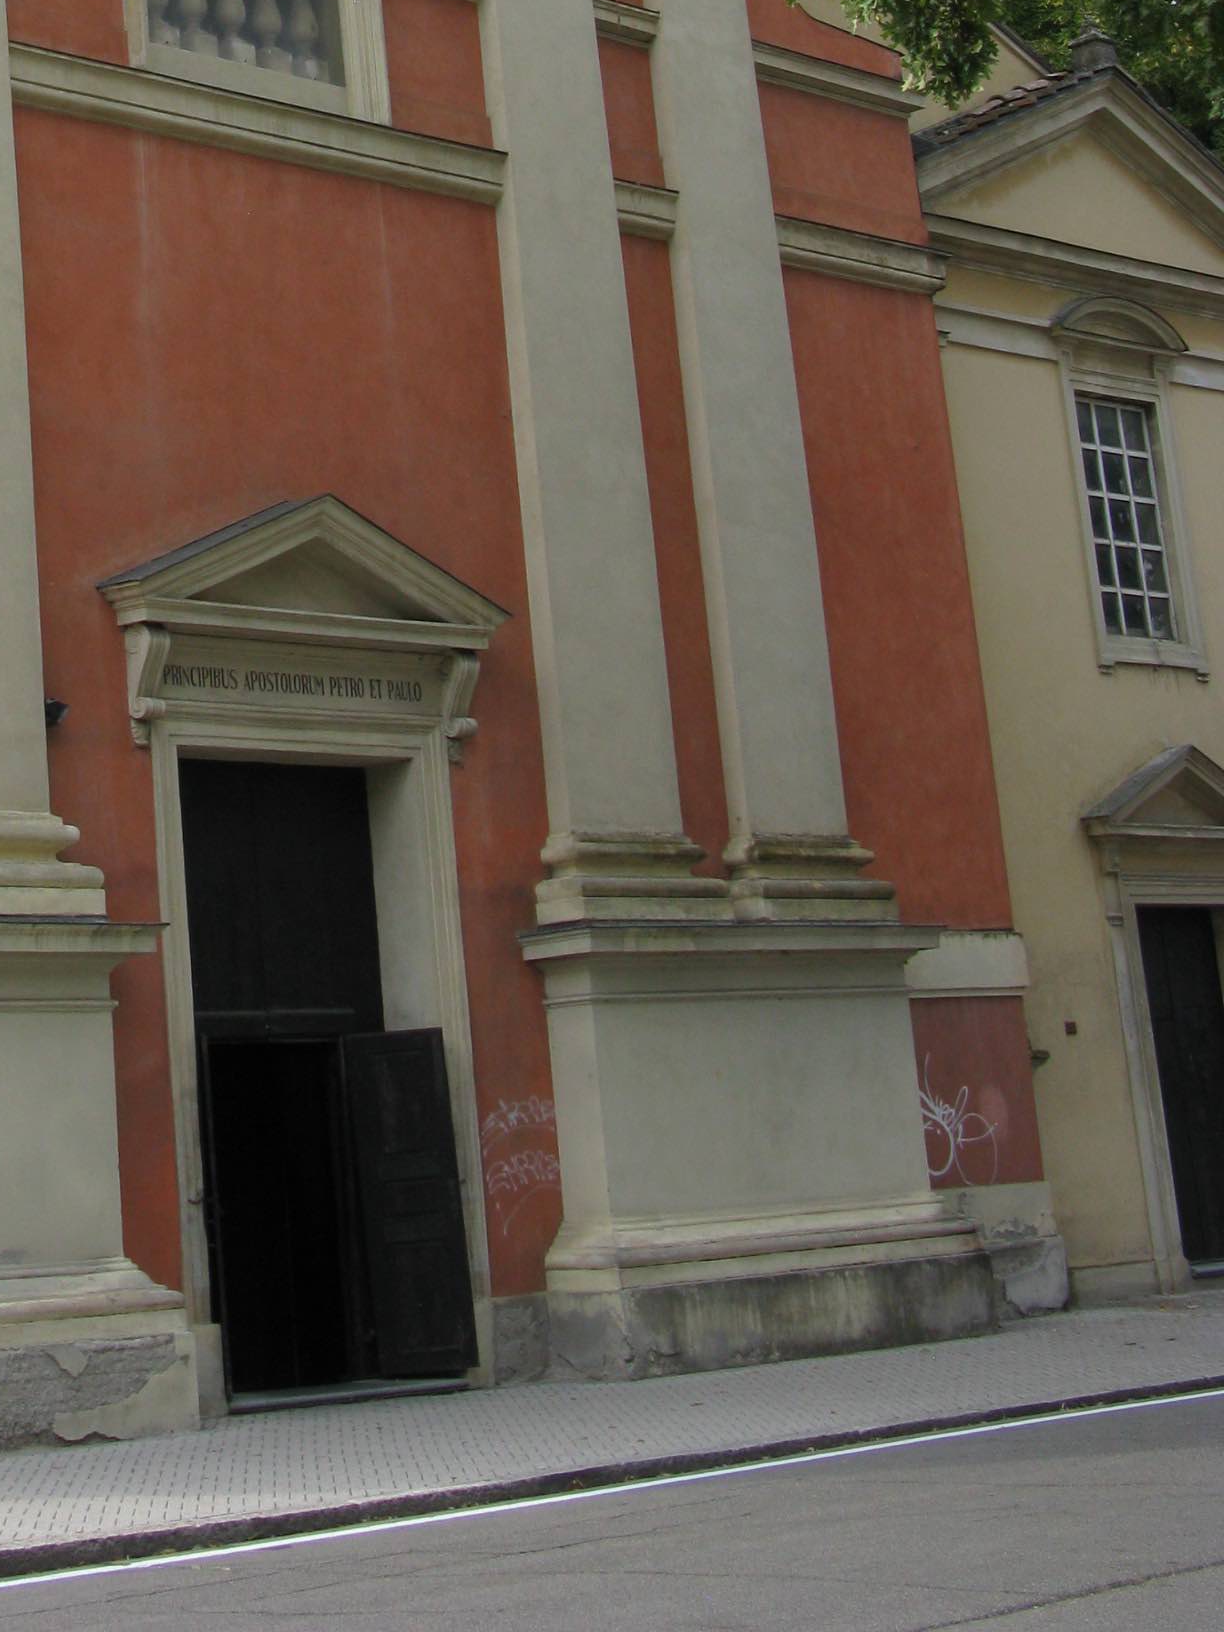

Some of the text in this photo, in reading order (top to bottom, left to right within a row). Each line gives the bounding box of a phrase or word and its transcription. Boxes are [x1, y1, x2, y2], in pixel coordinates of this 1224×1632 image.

[163, 664, 238, 689] PRINCIPIBUS
[244, 671, 326, 696] APOSTOLORUM
[328, 676, 364, 699] PETRO
[370, 678, 382, 700] ET
